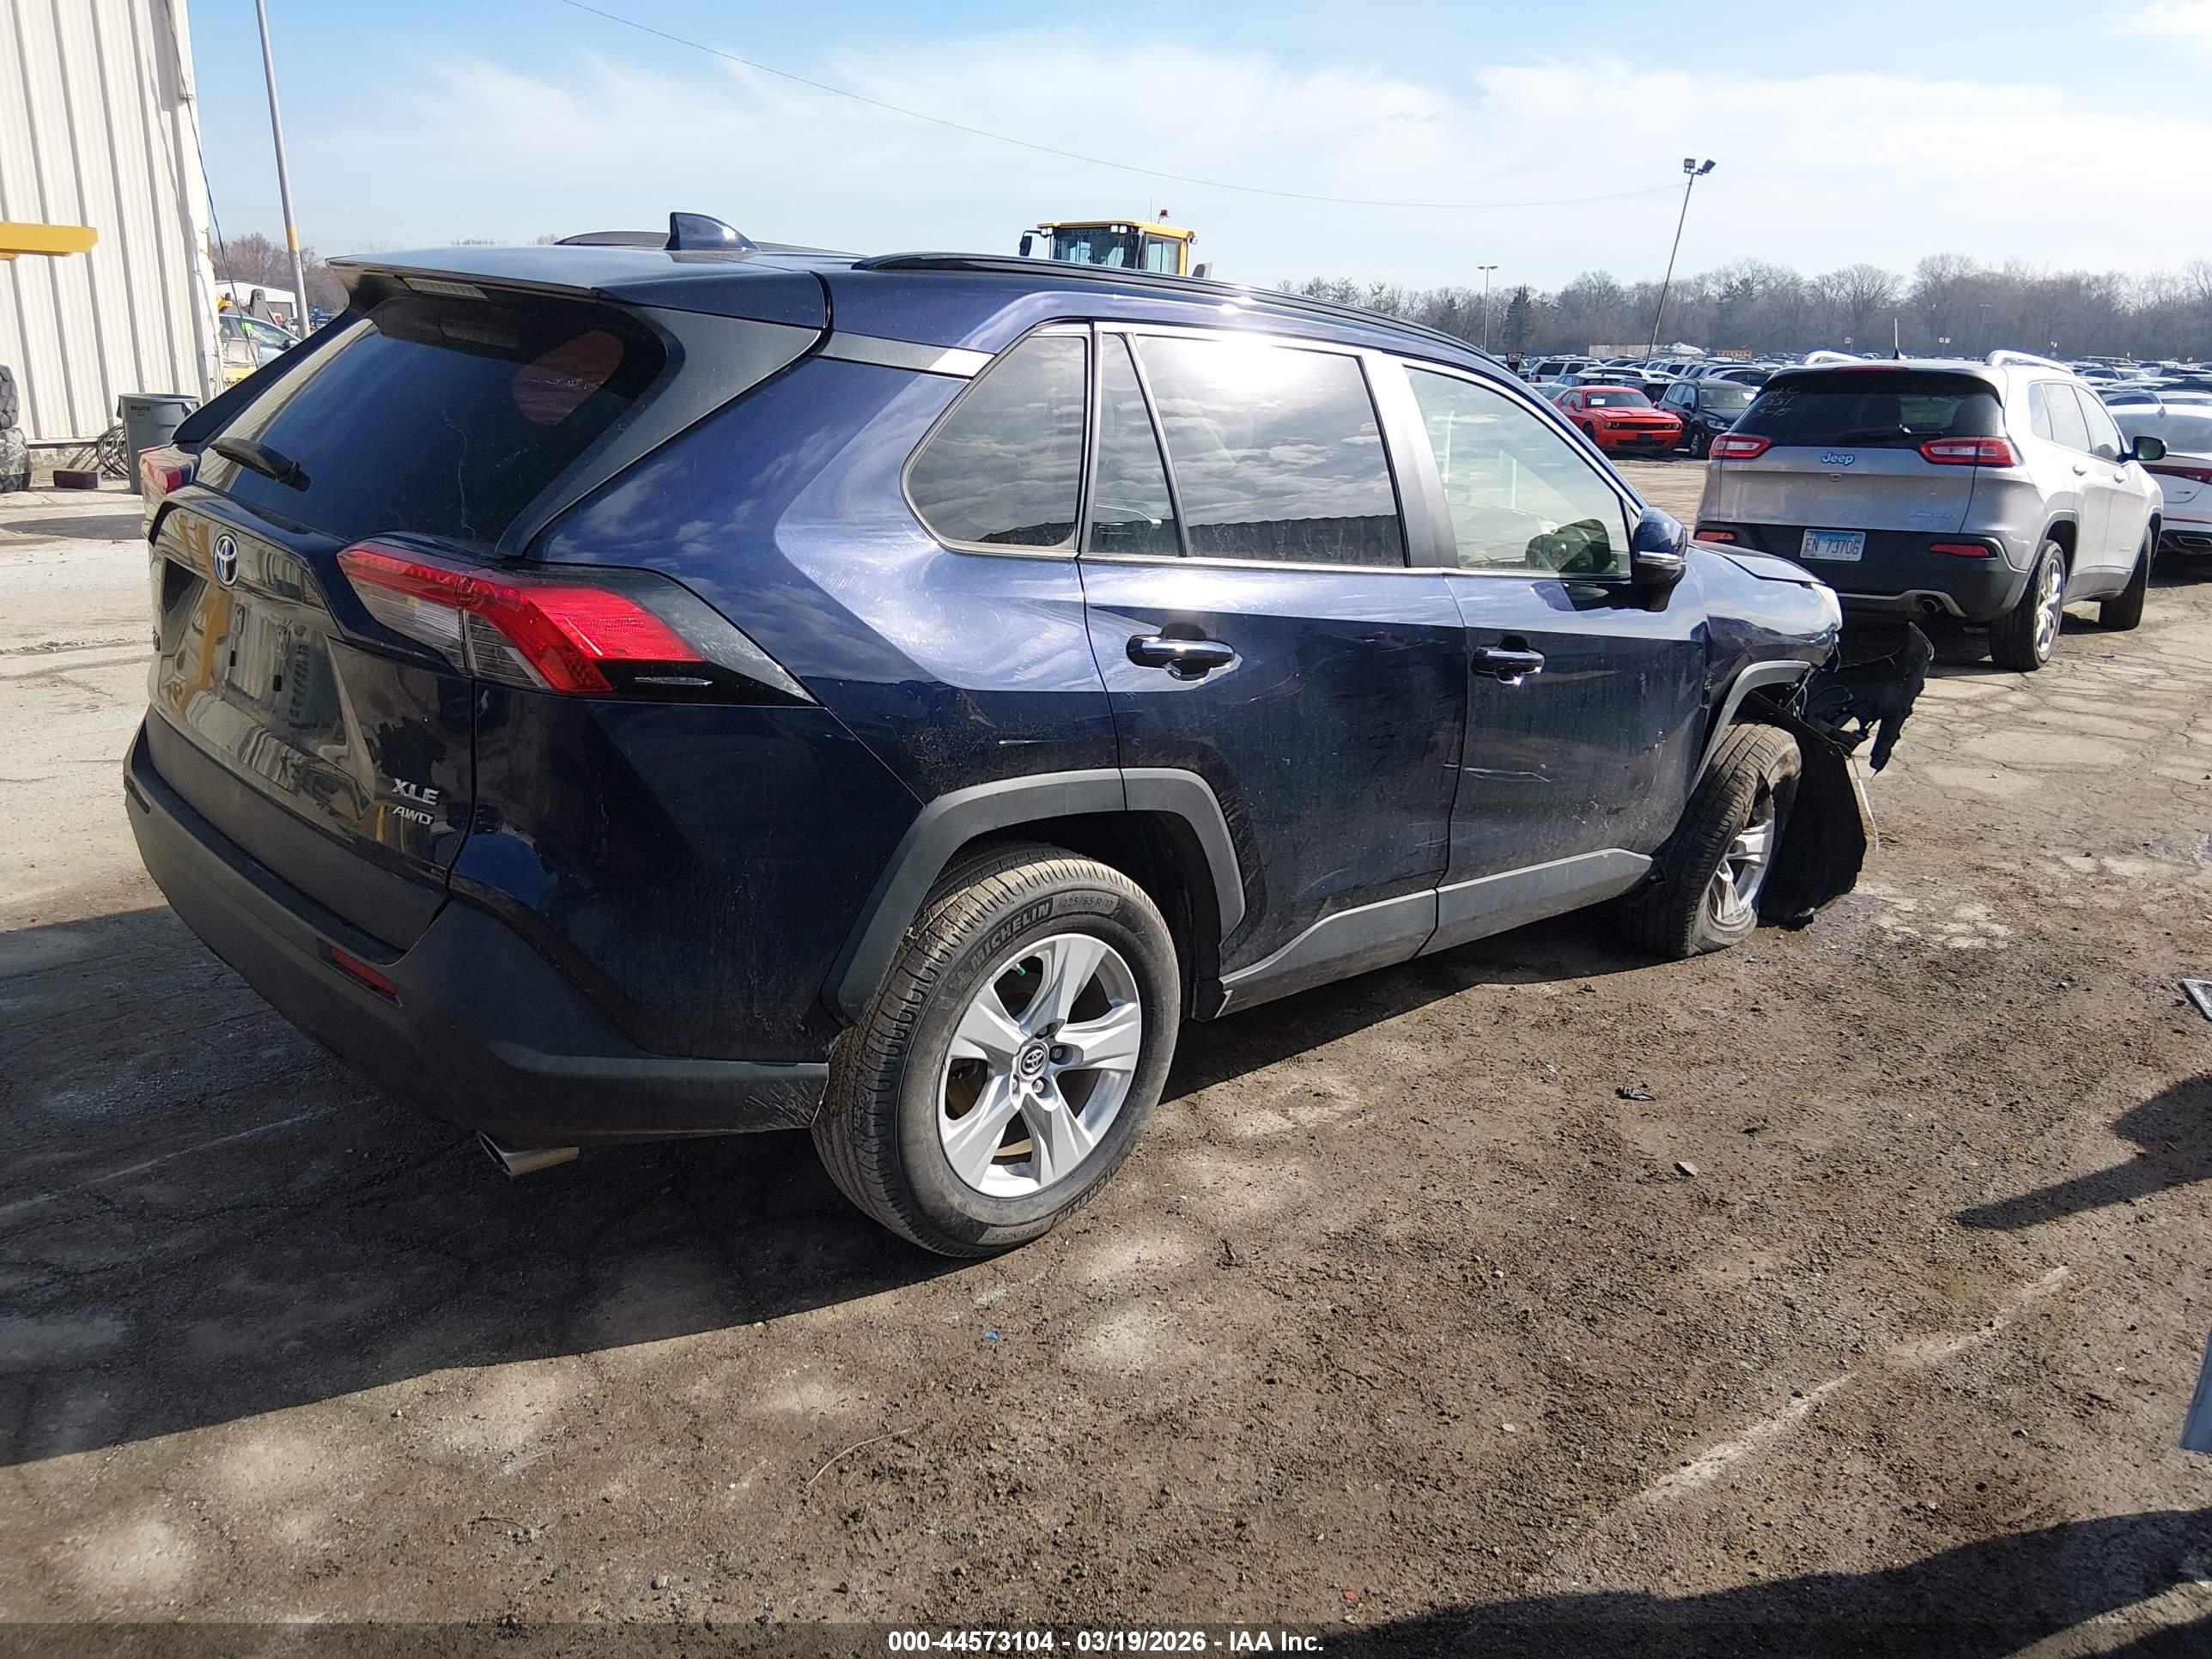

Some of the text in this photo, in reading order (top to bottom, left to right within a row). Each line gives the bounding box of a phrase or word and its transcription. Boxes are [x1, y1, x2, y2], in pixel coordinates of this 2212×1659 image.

[1821, 452, 1855, 466] Jeep
[1826, 538, 1861, 555] 73706
[392, 777, 441, 805] XLE
[392, 805, 434, 825] AWD
[969, 902, 1051, 970] MICHELIN
